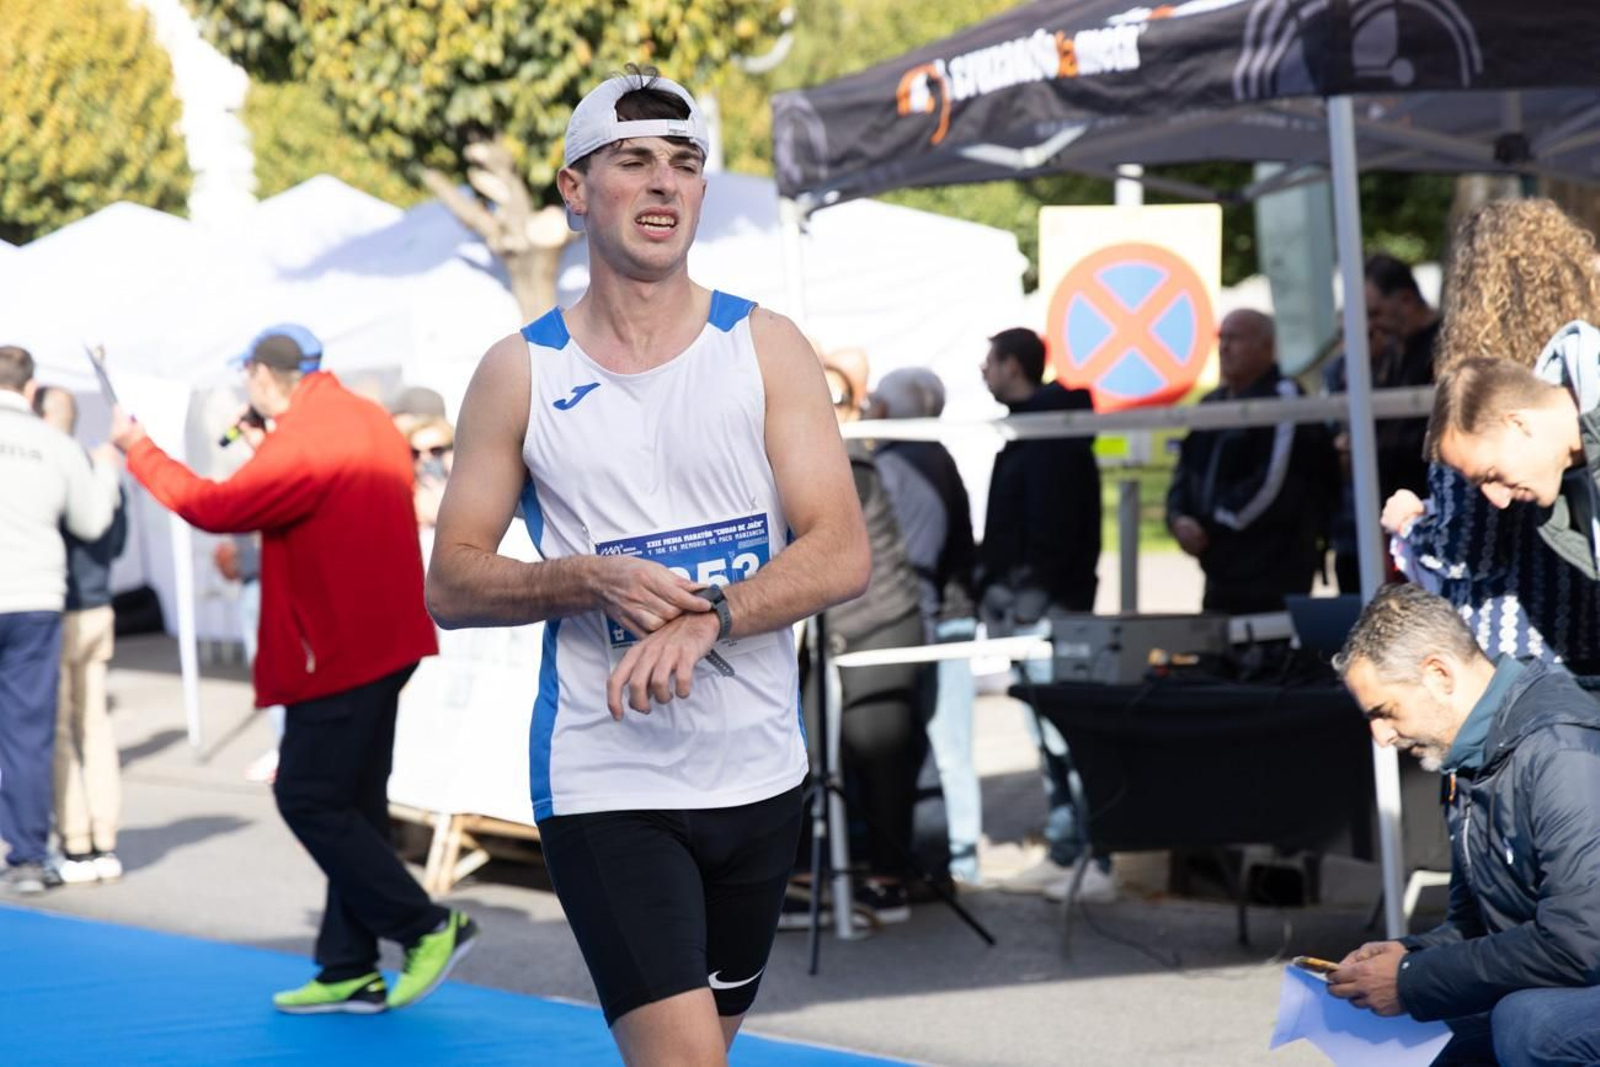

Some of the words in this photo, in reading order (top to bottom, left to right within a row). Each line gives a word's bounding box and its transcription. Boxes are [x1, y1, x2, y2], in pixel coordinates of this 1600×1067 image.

[663, 535, 683, 545] MEDIA
[737, 523, 746, 532] DE
[668, 544, 678, 552] EN
[680, 540, 707, 551] MEMORIA
[708, 538, 717, 546] DE
[718, 534, 733, 543] PACO
[668, 552, 760, 587] 53
